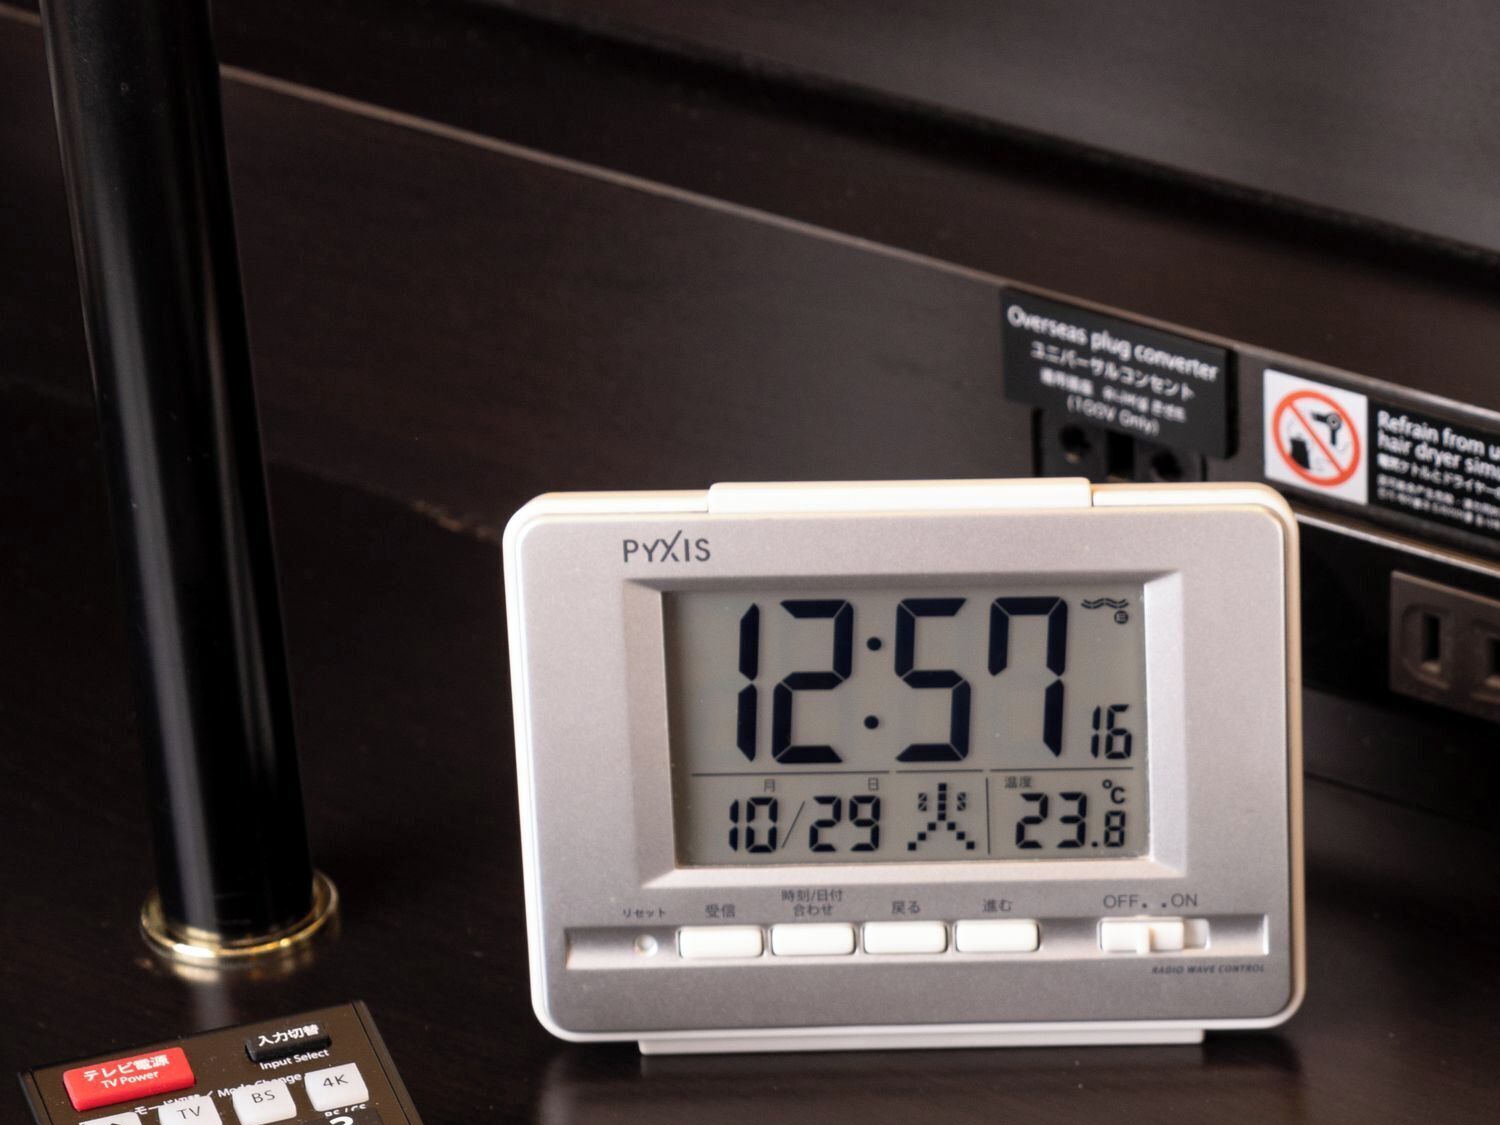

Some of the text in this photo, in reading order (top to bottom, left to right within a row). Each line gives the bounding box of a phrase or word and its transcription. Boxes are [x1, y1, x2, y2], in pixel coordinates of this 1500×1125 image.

[1007, 304, 1088, 346] Overseas
[1090, 329, 1132, 362] plug
[1134, 344, 1220, 382] converter
[1030, 340, 1196, 402] ユニバーサルコンセント
[1377, 409, 1440, 445] Refrain
[1442, 426, 1486, 458] from
[1377, 428, 1413, 457] hair
[1414, 440, 1462, 469] dryer
[622, 529, 712, 563] PYXIS
[736, 596, 1068, 764] 12:57
[1090, 703, 1132, 760] 16
[763, 778, 776, 793] 月
[867, 777, 879, 792] 日
[1004, 776, 1033, 789] 温度
[728, 795, 881, 854] 10/29
[1014, 790, 1127, 850] 23.8
[780, 888, 844, 902] 時刻/日付
[622, 906, 668, 919] リセット
[704, 903, 737, 919] 受信
[792, 902, 834, 917] 合わせ
[890, 900, 922, 915] 戻る
[982, 898, 1013, 913] 進む
[1151, 962, 1265, 975] RADIO WAVE CONTROL
[258, 1024, 319, 1047] 入力切替
[83, 1054, 170, 1082] テレビ電源
[259, 1049, 330, 1070] Input Select
[100, 1069, 160, 1089] TV Power
[322, 1073, 349, 1088] 4K
[251, 1089, 276, 1104] BS
[176, 1105, 201, 1120] TV
